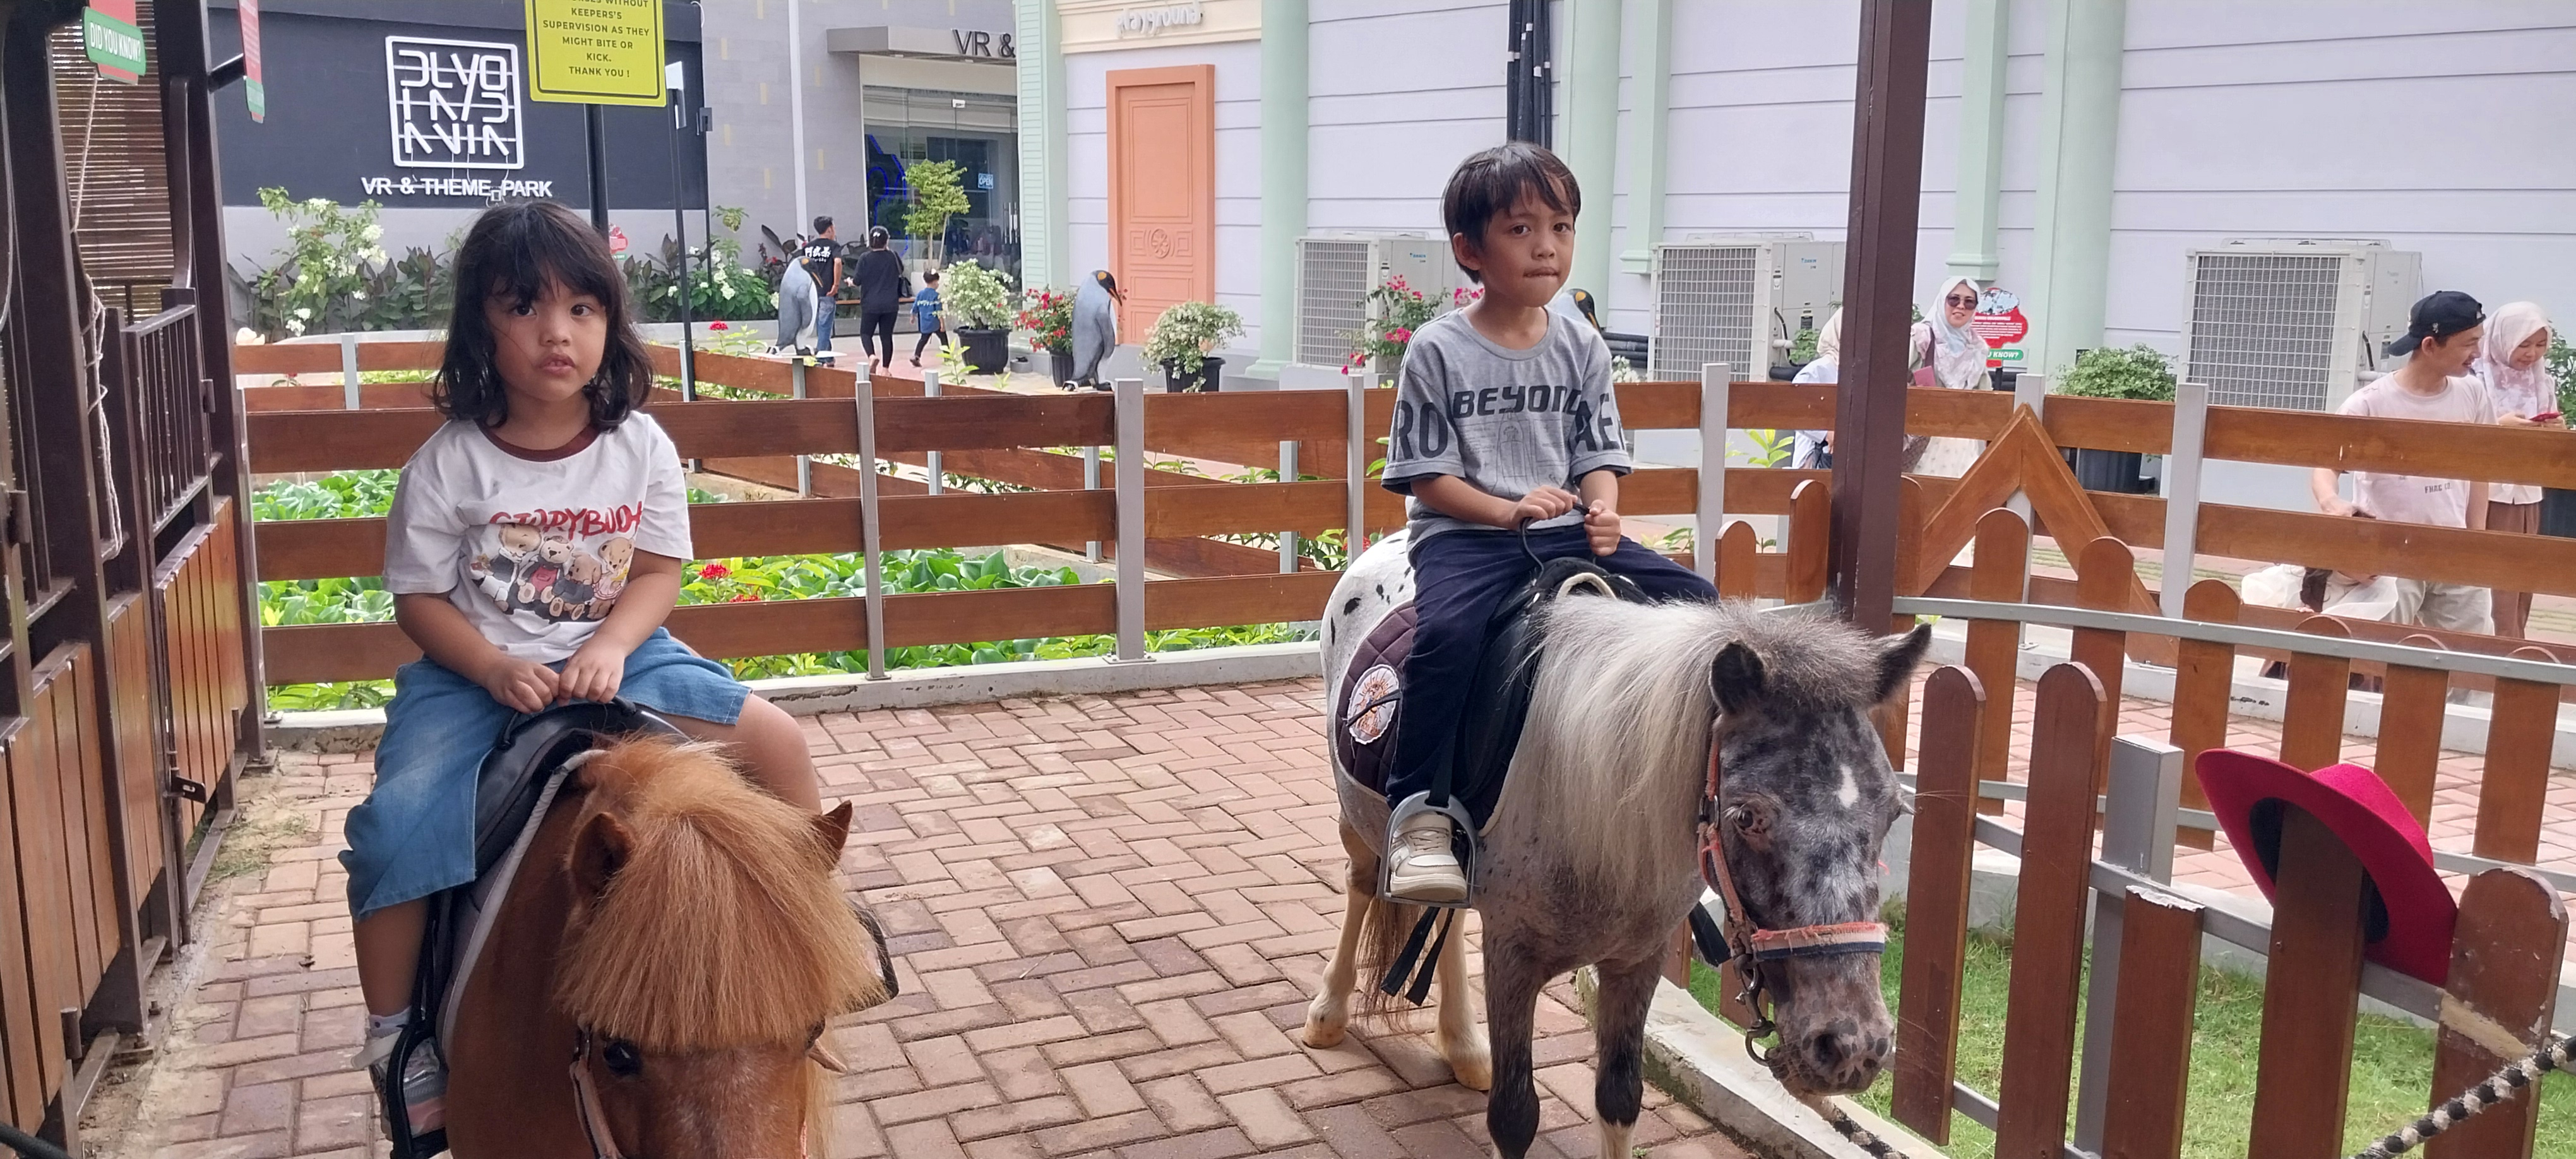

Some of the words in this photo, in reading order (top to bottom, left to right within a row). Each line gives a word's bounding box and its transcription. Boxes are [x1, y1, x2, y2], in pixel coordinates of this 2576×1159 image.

[571, 7, 622, 20] KEEPERS'S
[542, 20, 608, 33] SUPERVISION
[611, 25, 623, 34] AS
[626, 27, 650, 36] THEY
[90, 22, 103, 50] DID
[103, 27, 117, 56] YOU
[118, 32, 141, 62] KNOW?
[562, 36, 593, 47] MIGHT
[596, 39, 617, 49] BITE
[620, 40, 633, 49] OR
[951, 28, 991, 56] VR
[998, 33, 1016, 58] &
[586, 52, 612, 62] KICK.
[569, 66, 602, 76] THANK
[604, 68, 624, 77] YOU
[361, 177, 392, 195] VR
[399, 177, 415, 194] &
[420, 178, 491, 197] THEME
[501, 180, 552, 197] PARK
